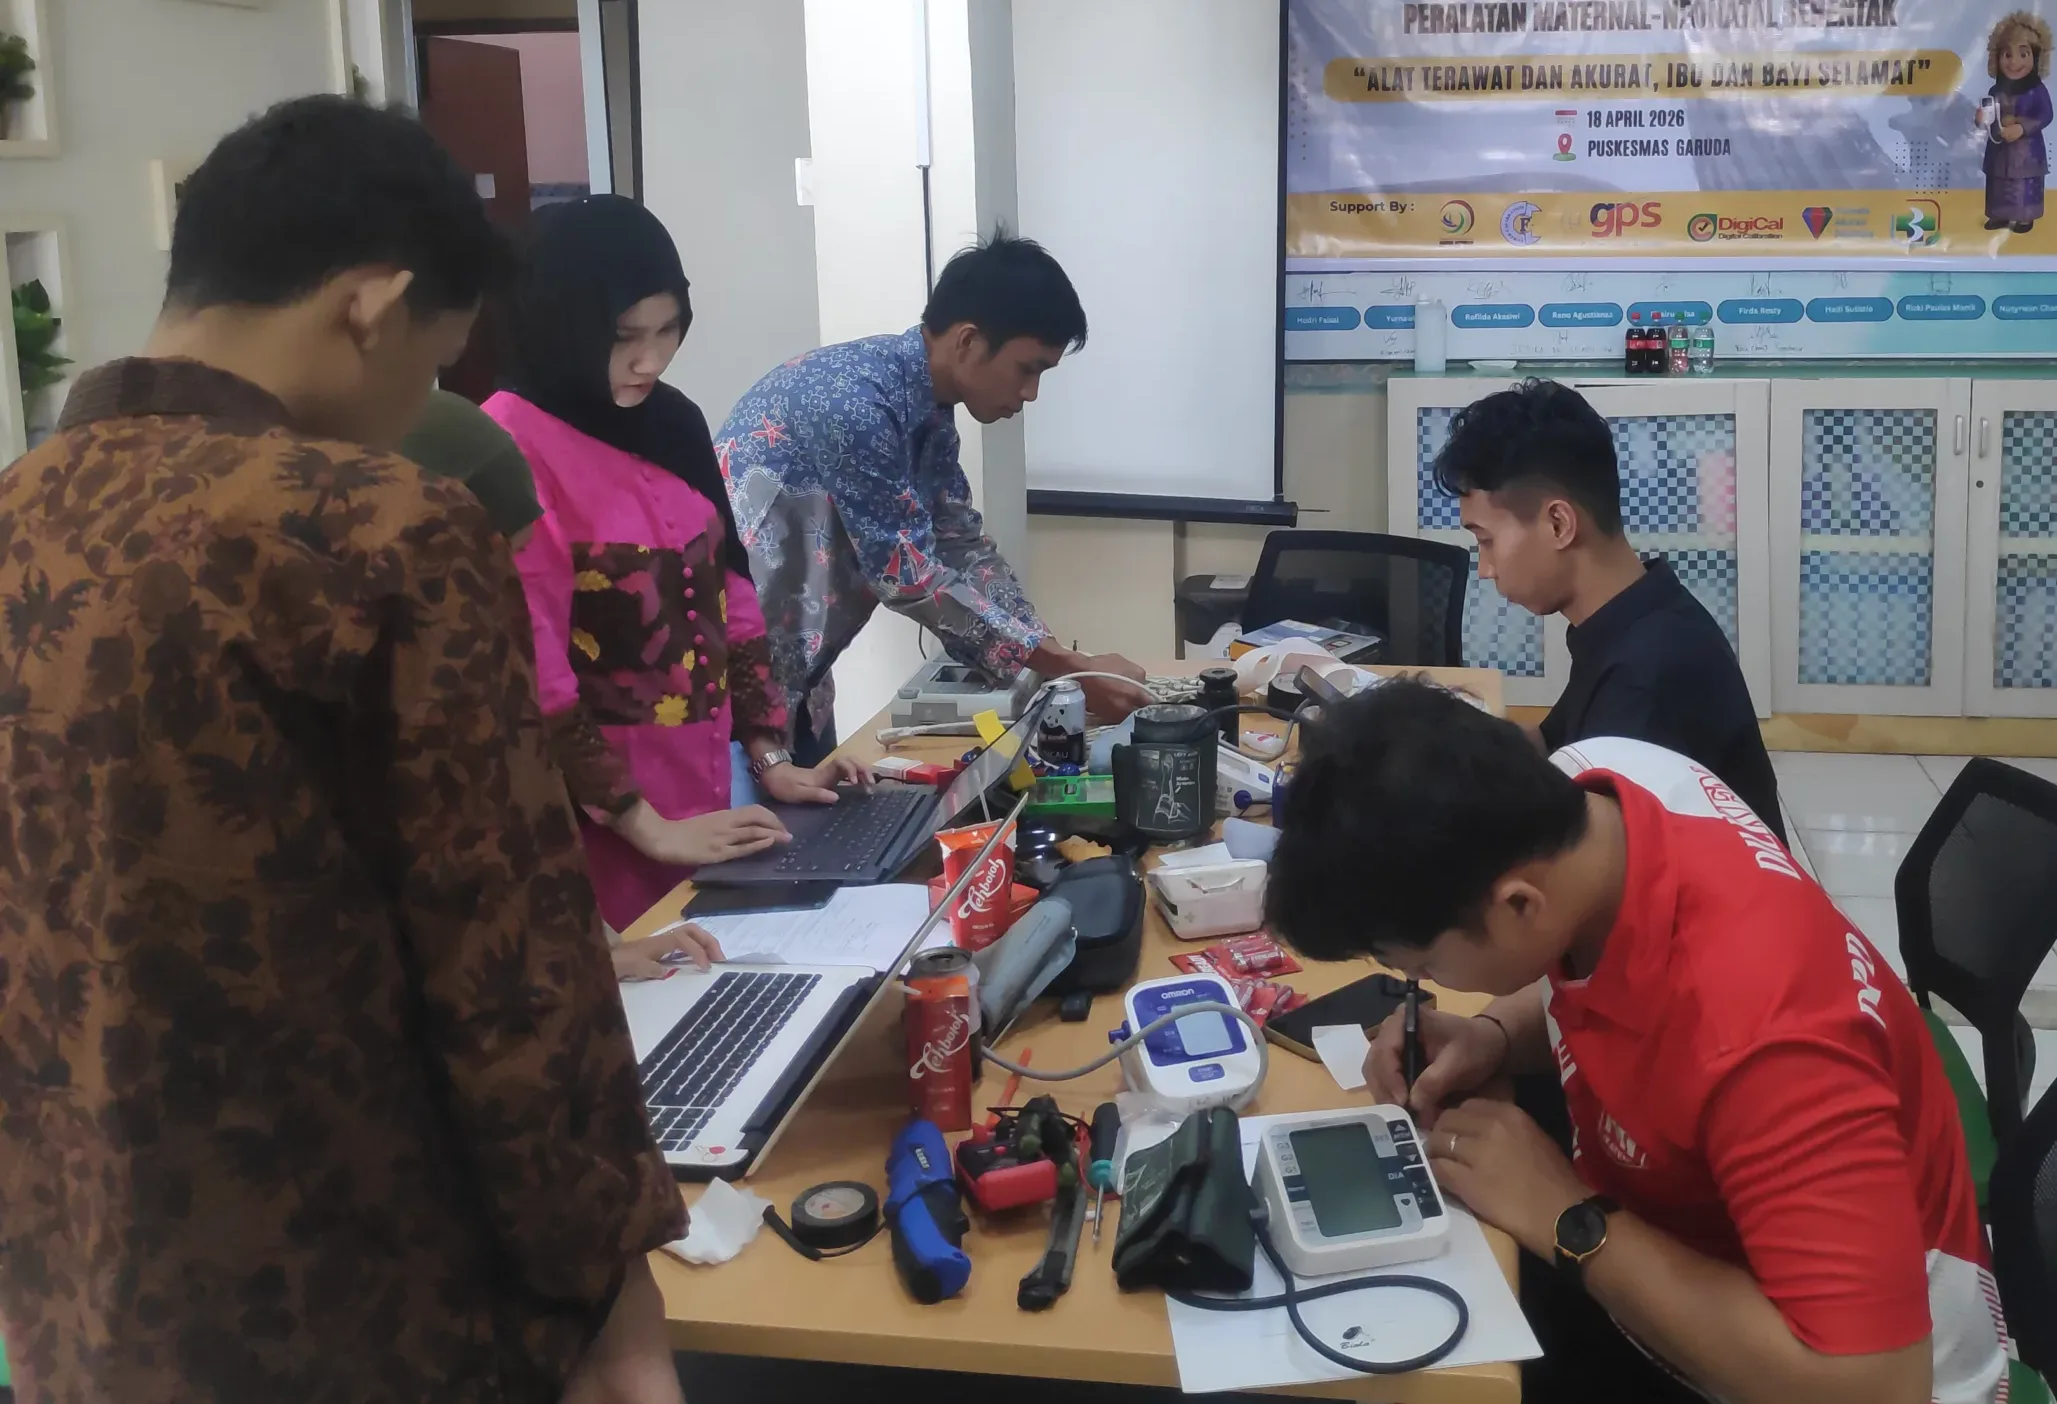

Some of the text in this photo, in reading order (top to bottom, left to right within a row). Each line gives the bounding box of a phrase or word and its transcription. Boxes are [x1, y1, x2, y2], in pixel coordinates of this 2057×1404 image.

[1403, 2, 1527, 34] PERALATAN
[1421, 64, 1515, 92] TERAWAT
[1521, 63, 1563, 91] DAN
[1666, 62, 1703, 88] IBU
[1710, 61, 1754, 88] DAN
[1761, 60, 1811, 87] BAYI
[1586, 109, 1685, 128] 18 APRIL 2026
[1587, 137, 1732, 157] PUSKESMAS GARUDA
[1329, 200, 1386, 215] Support
[1389, 201, 1408, 214] By
[1590, 201, 1663, 238] gps
[1718, 216, 1784, 234] DigiCal
[1161, 988, 1195, 1000] OMRON
[1388, 1171, 1405, 1180] DIA
